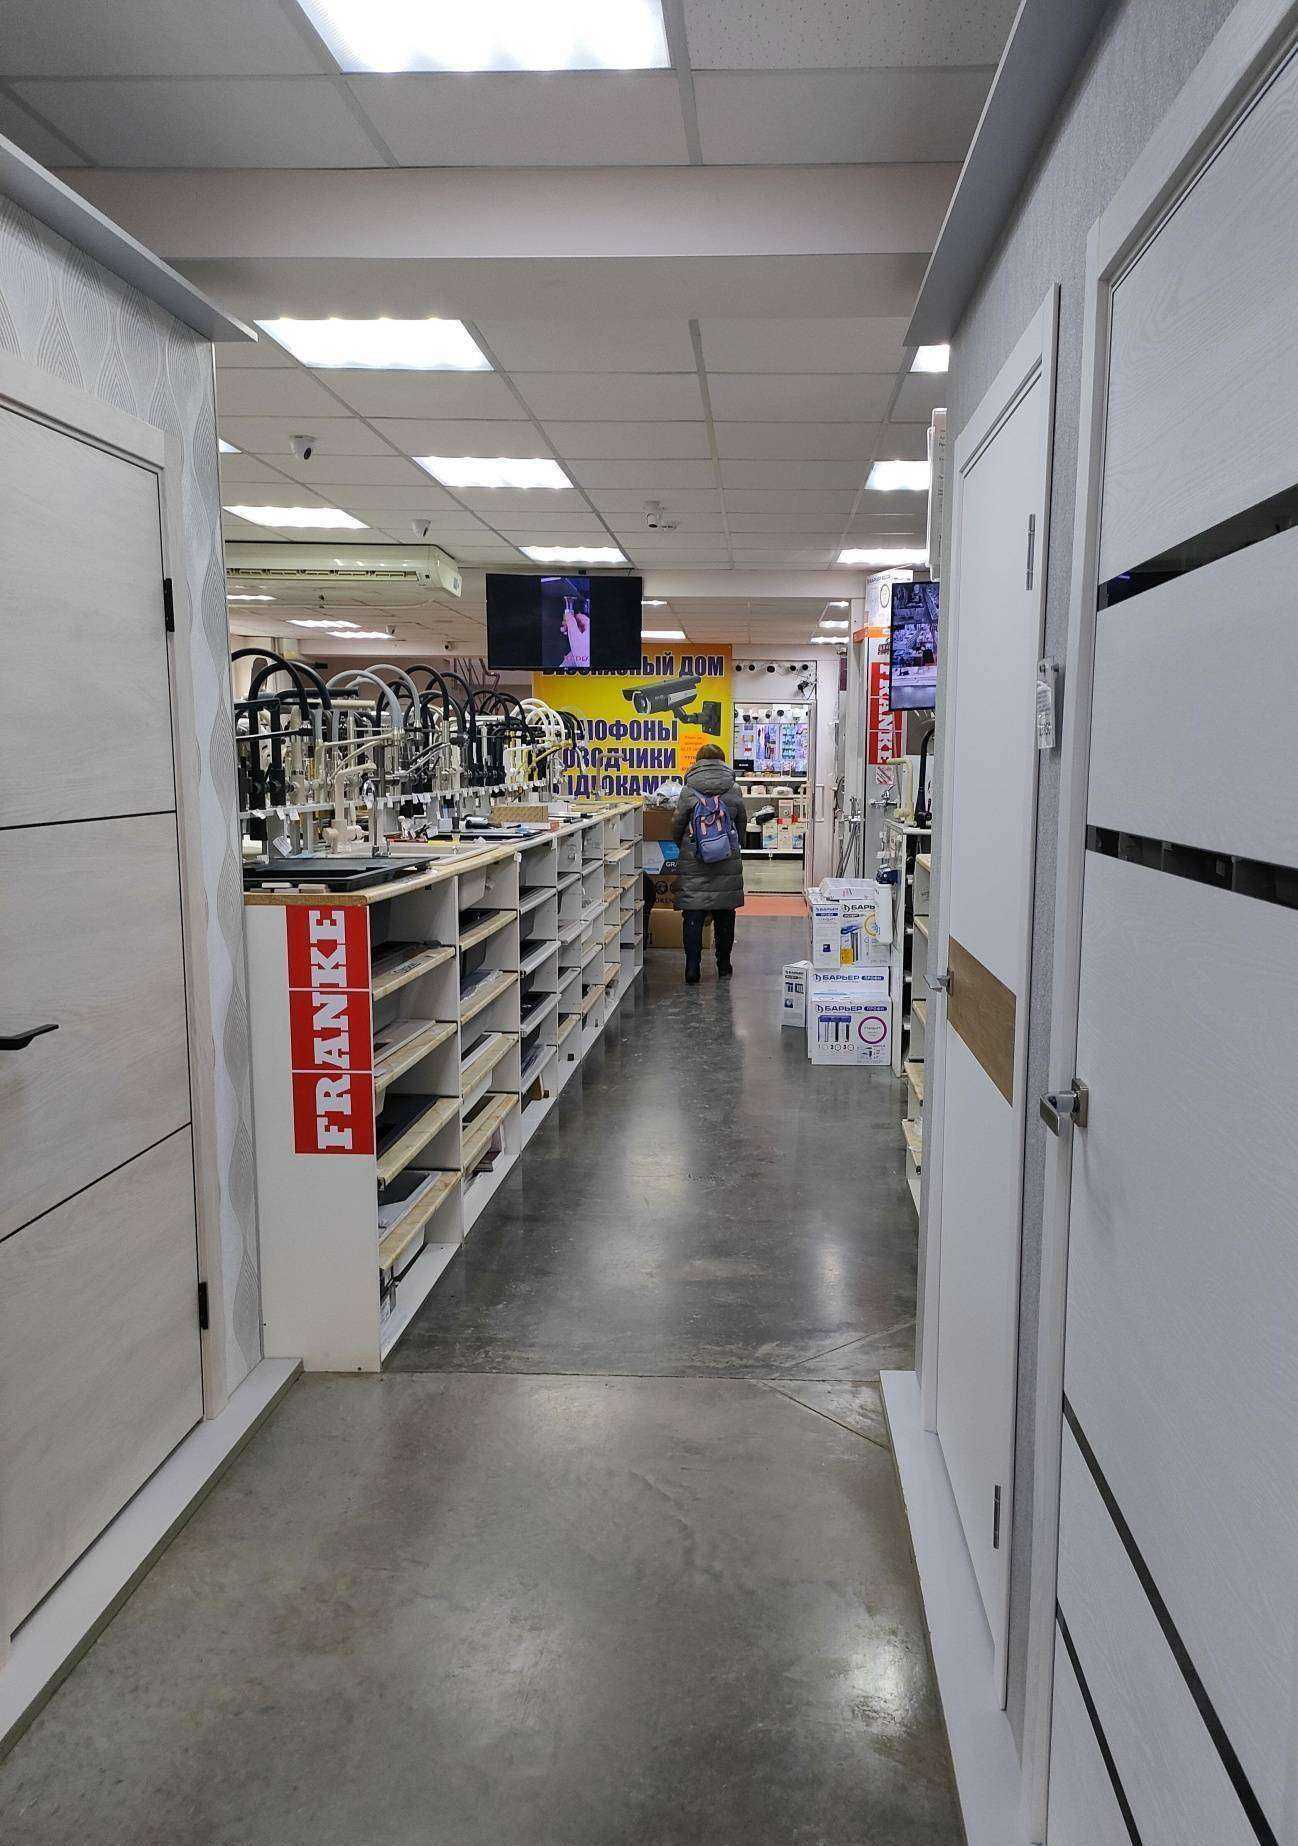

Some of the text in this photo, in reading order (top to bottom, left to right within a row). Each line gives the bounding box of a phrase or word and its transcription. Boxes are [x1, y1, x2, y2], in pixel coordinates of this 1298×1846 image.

[679, 656, 724, 677] ДОМ
[563, 747, 676, 771] ОВОДЧИКИ
[309, 909, 353, 1150] FRANKE
